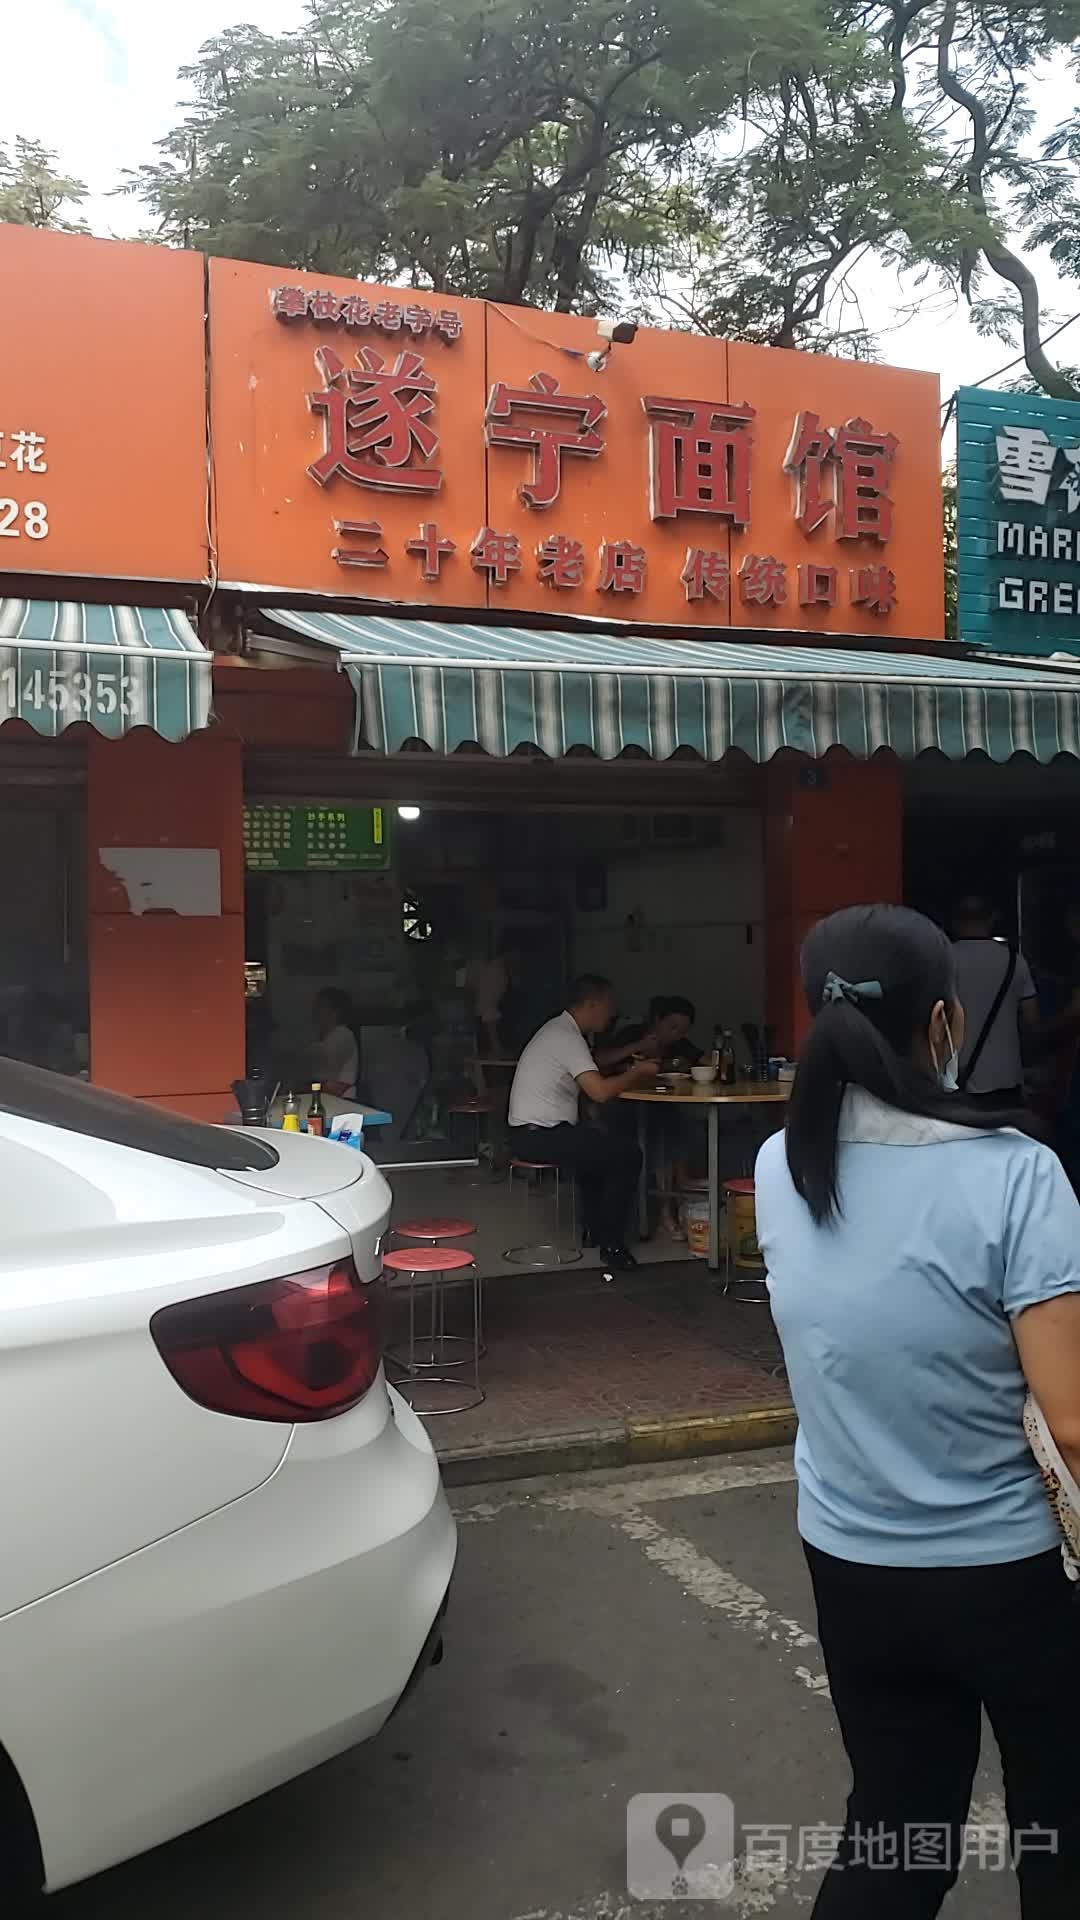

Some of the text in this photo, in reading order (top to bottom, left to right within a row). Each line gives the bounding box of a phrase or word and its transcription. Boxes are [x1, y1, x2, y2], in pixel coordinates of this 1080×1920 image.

[273, 286, 462, 339] 攀枝花老字号
[307, 345, 898, 543] 遂宁面馆
[331, 520, 898, 613] 二十年老店 传统口味
[998, 520, 1080, 562] MAR
[1000, 577, 1080, 614] GRE
